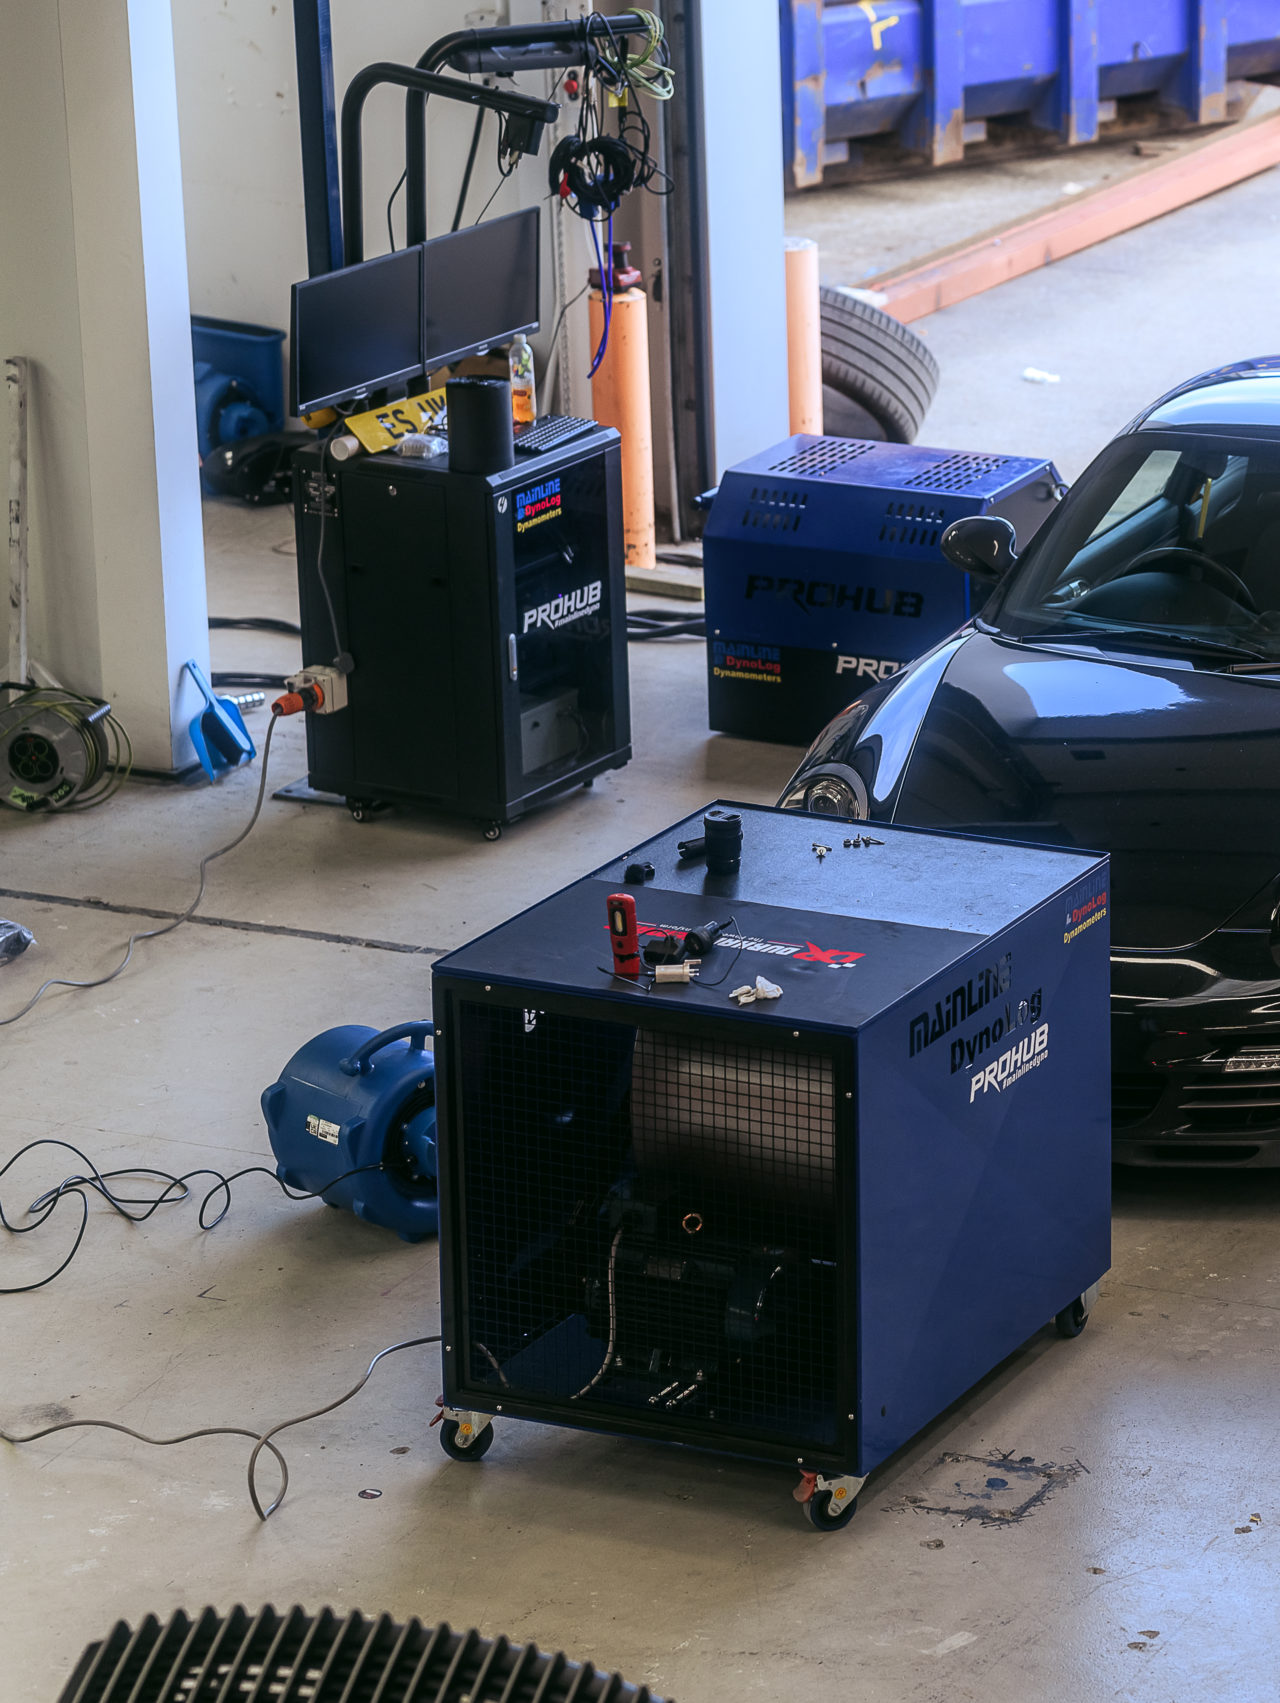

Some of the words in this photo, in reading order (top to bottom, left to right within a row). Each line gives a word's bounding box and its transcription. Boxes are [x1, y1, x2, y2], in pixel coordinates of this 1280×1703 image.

[517, 507, 562, 533] Dynamometers
[525, 494, 561, 517] DynoLog
[523, 580, 602, 633] PROHUB
[745, 574, 924, 618] PROHUB
[713, 667, 782, 683] Dynamometers
[726, 656, 781, 673] DynoLog
[836, 655, 906, 683] PRO
[1072, 891, 1107, 922] DynoLog
[1063, 907, 1107, 944] Dynamometers
[970, 1023, 1049, 1104] PROHUB
[1003, 1050, 1049, 1090] #mainlinedyno
